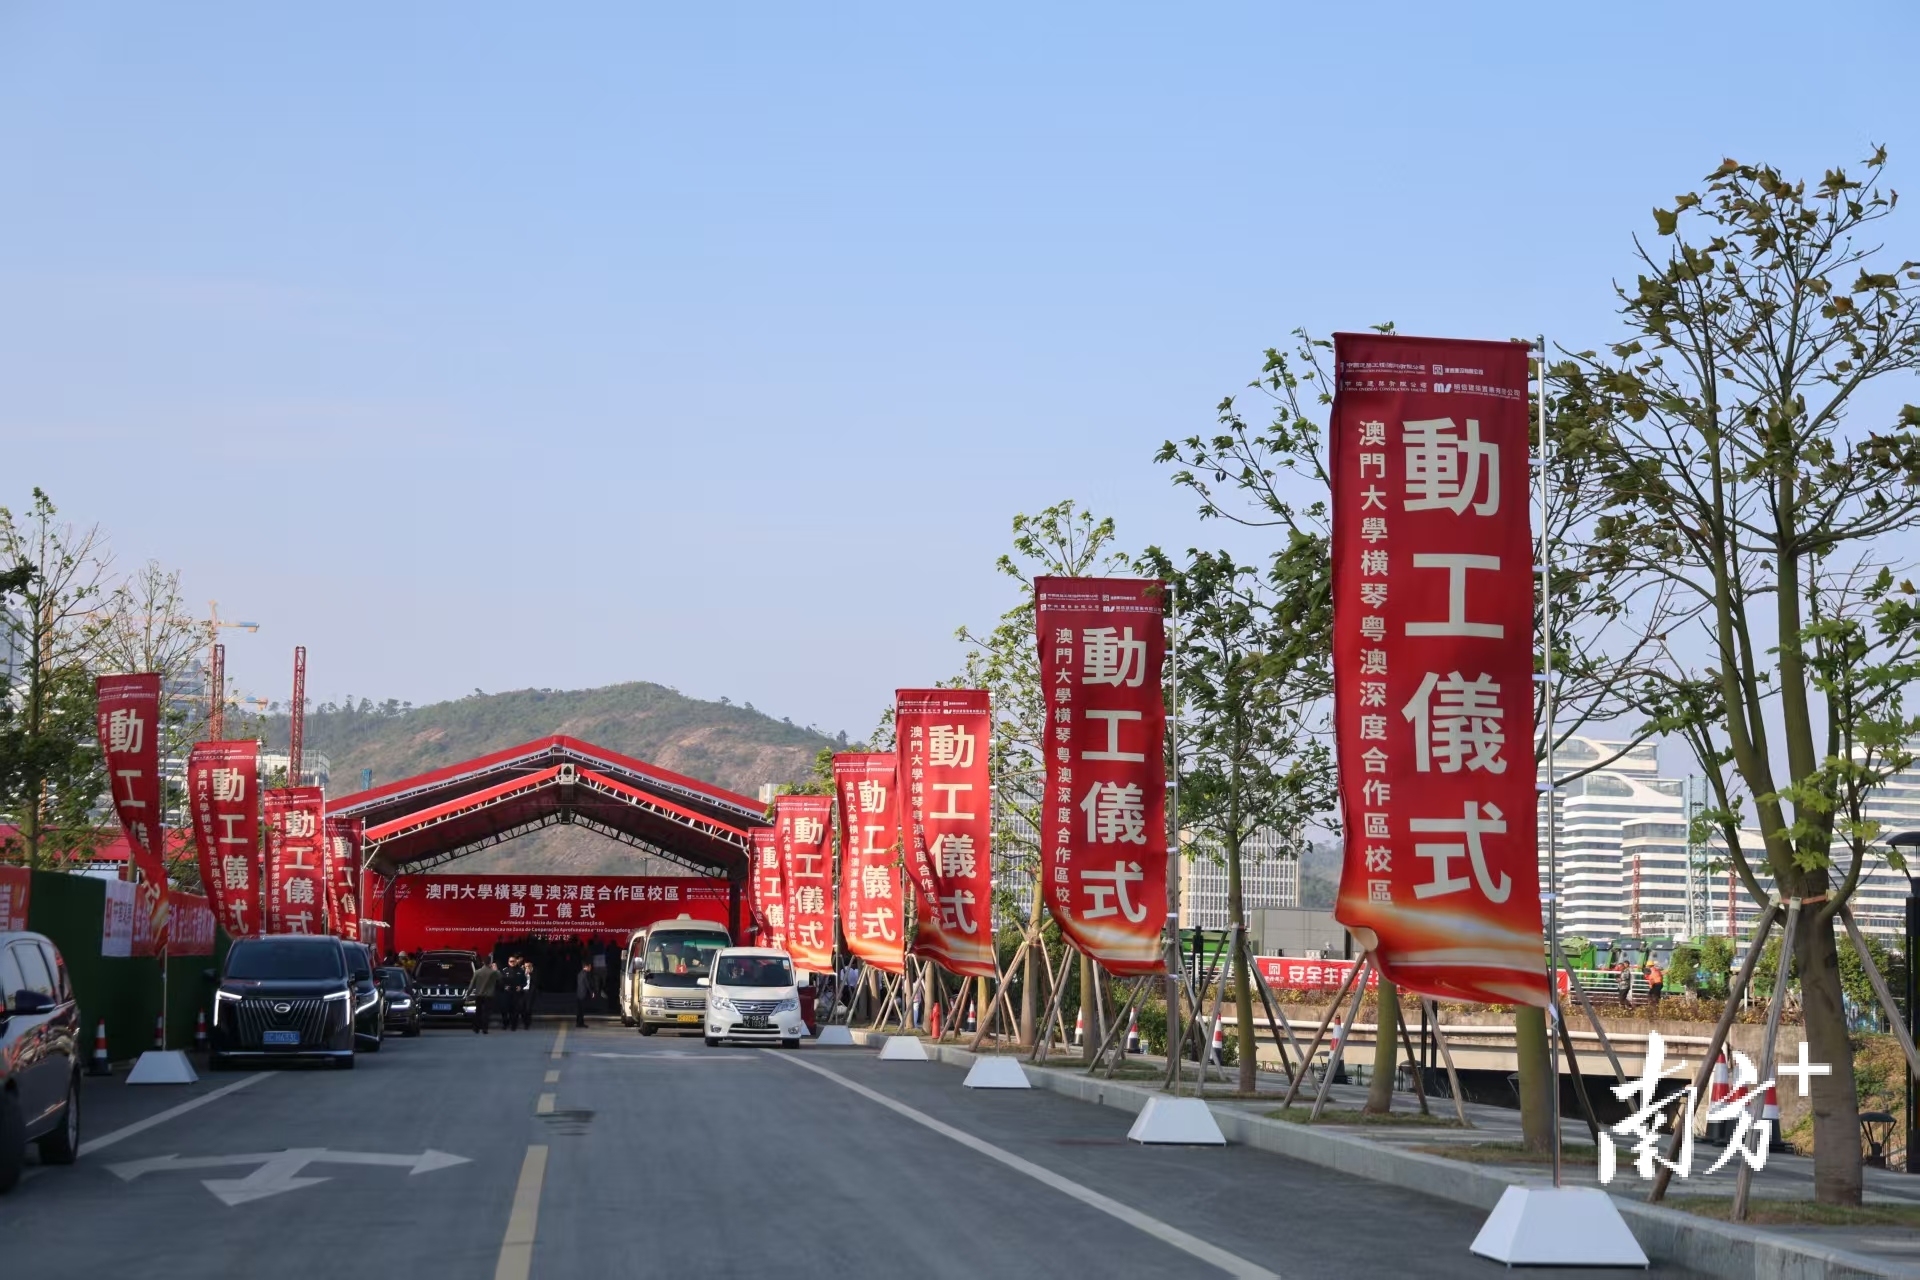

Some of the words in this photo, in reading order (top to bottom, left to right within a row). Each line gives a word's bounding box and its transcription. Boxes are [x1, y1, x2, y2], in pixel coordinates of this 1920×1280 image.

[1401, 417, 1512, 905] 動工儀式
[212, 767, 249, 934] 動工儀式
[929, 725, 977, 935] 動工儀式
[1080, 626, 1147, 923] 動工儀式
[509, 902, 596, 919] 動工儀式
[794, 817, 825, 949] 動工儀式
[858, 780, 896, 942] 動工儀式
